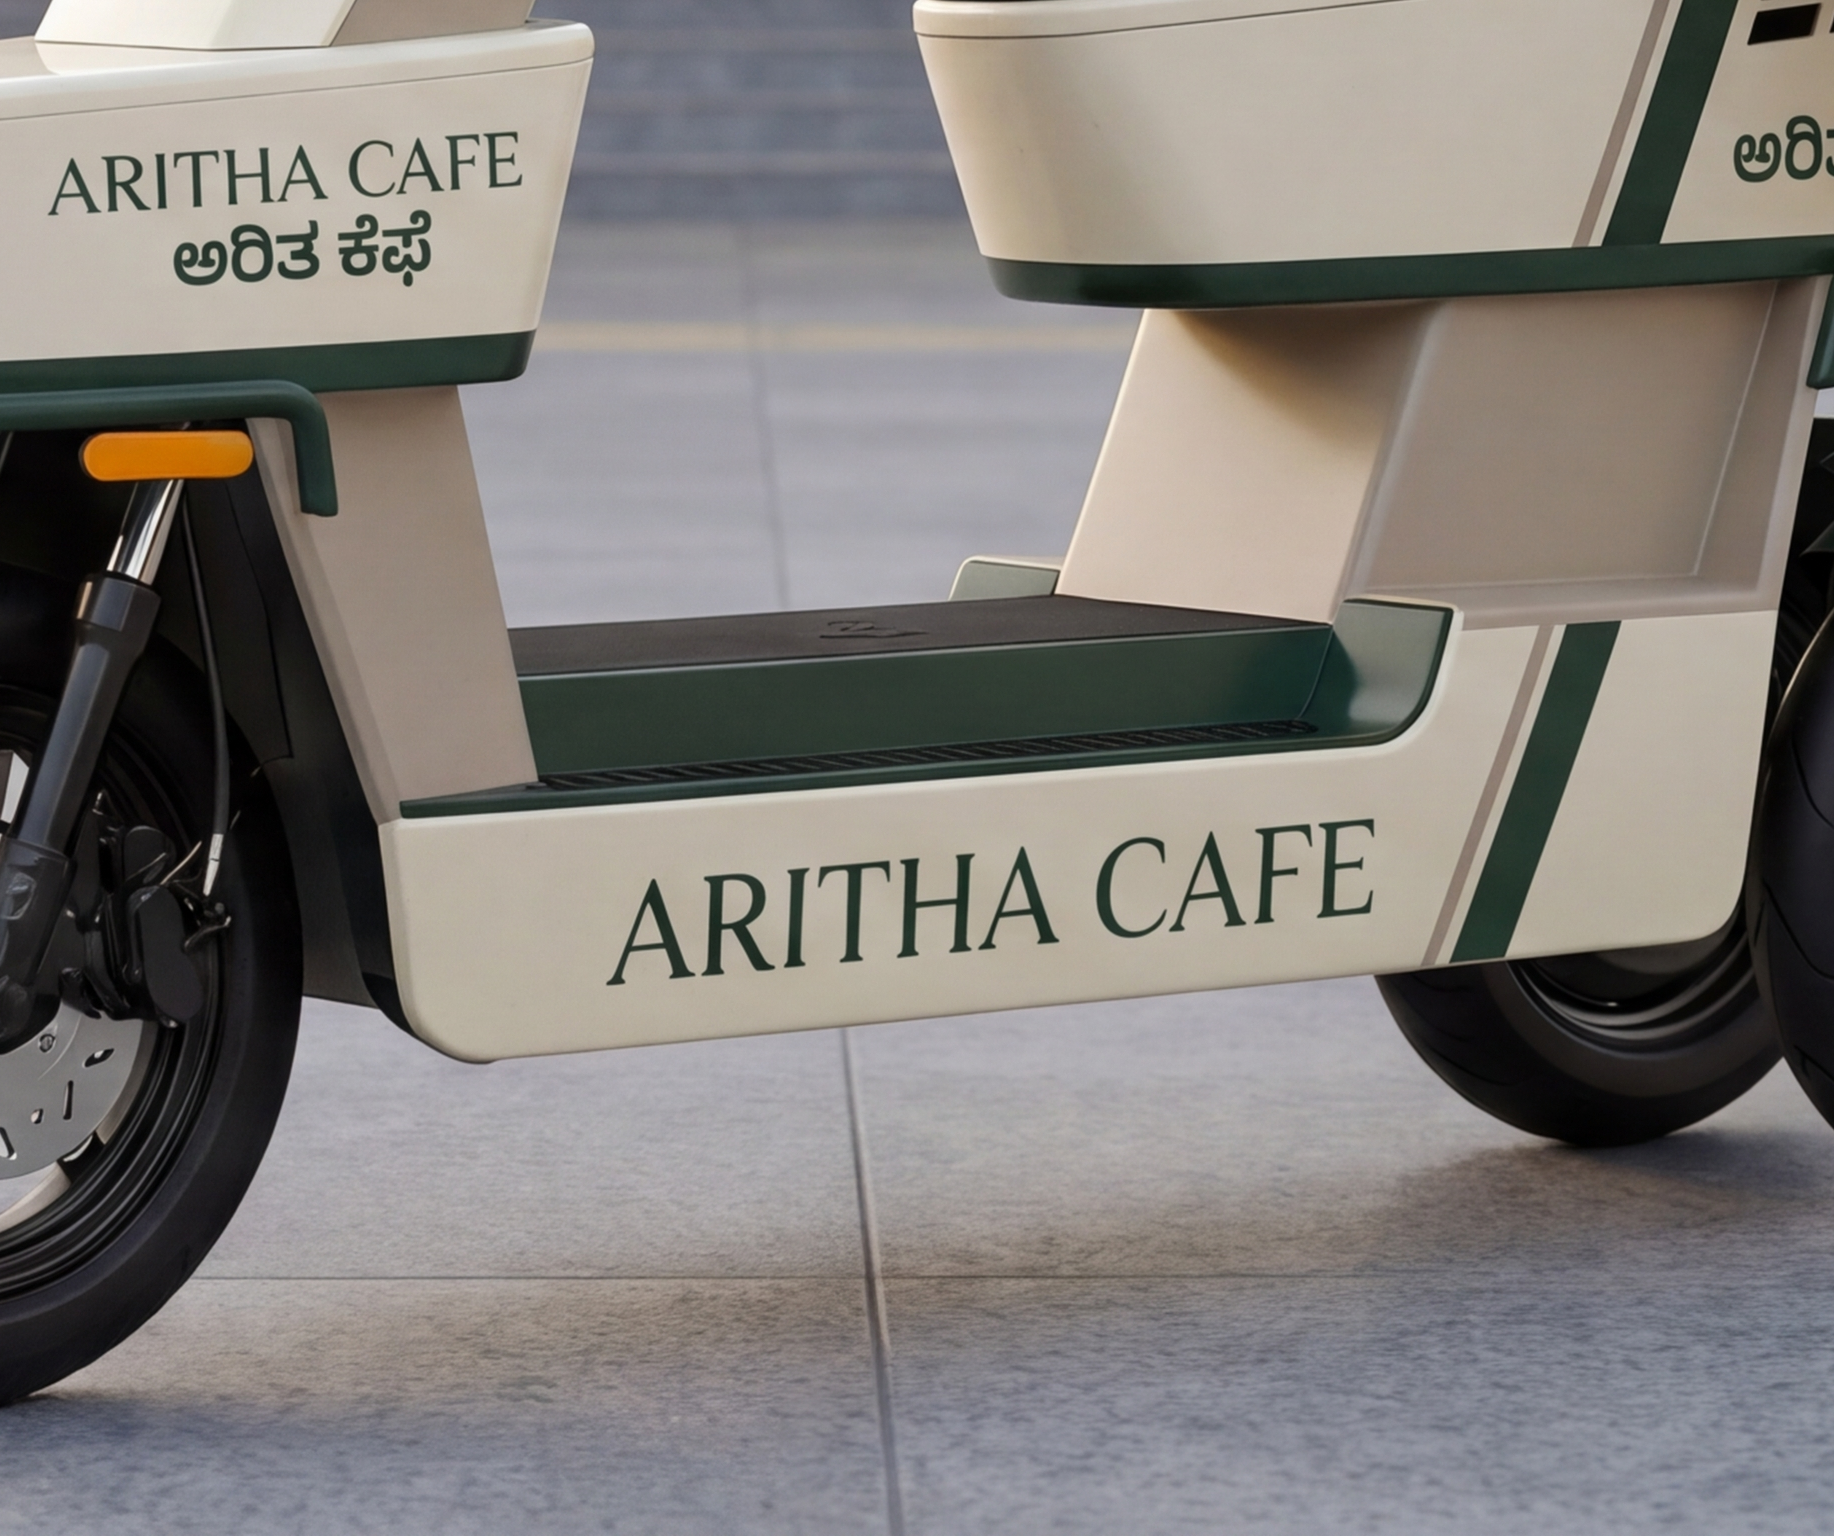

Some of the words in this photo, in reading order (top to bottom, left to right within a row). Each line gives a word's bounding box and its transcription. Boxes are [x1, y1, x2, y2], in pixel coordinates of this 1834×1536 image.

[47, 144, 329, 217] ARITHA
[348, 130, 524, 198] CAFE
[173, 219, 321, 287] ಅರಿತ
[605, 845, 1060, 987] ARITHA
[1095, 817, 1376, 939] CAFE
